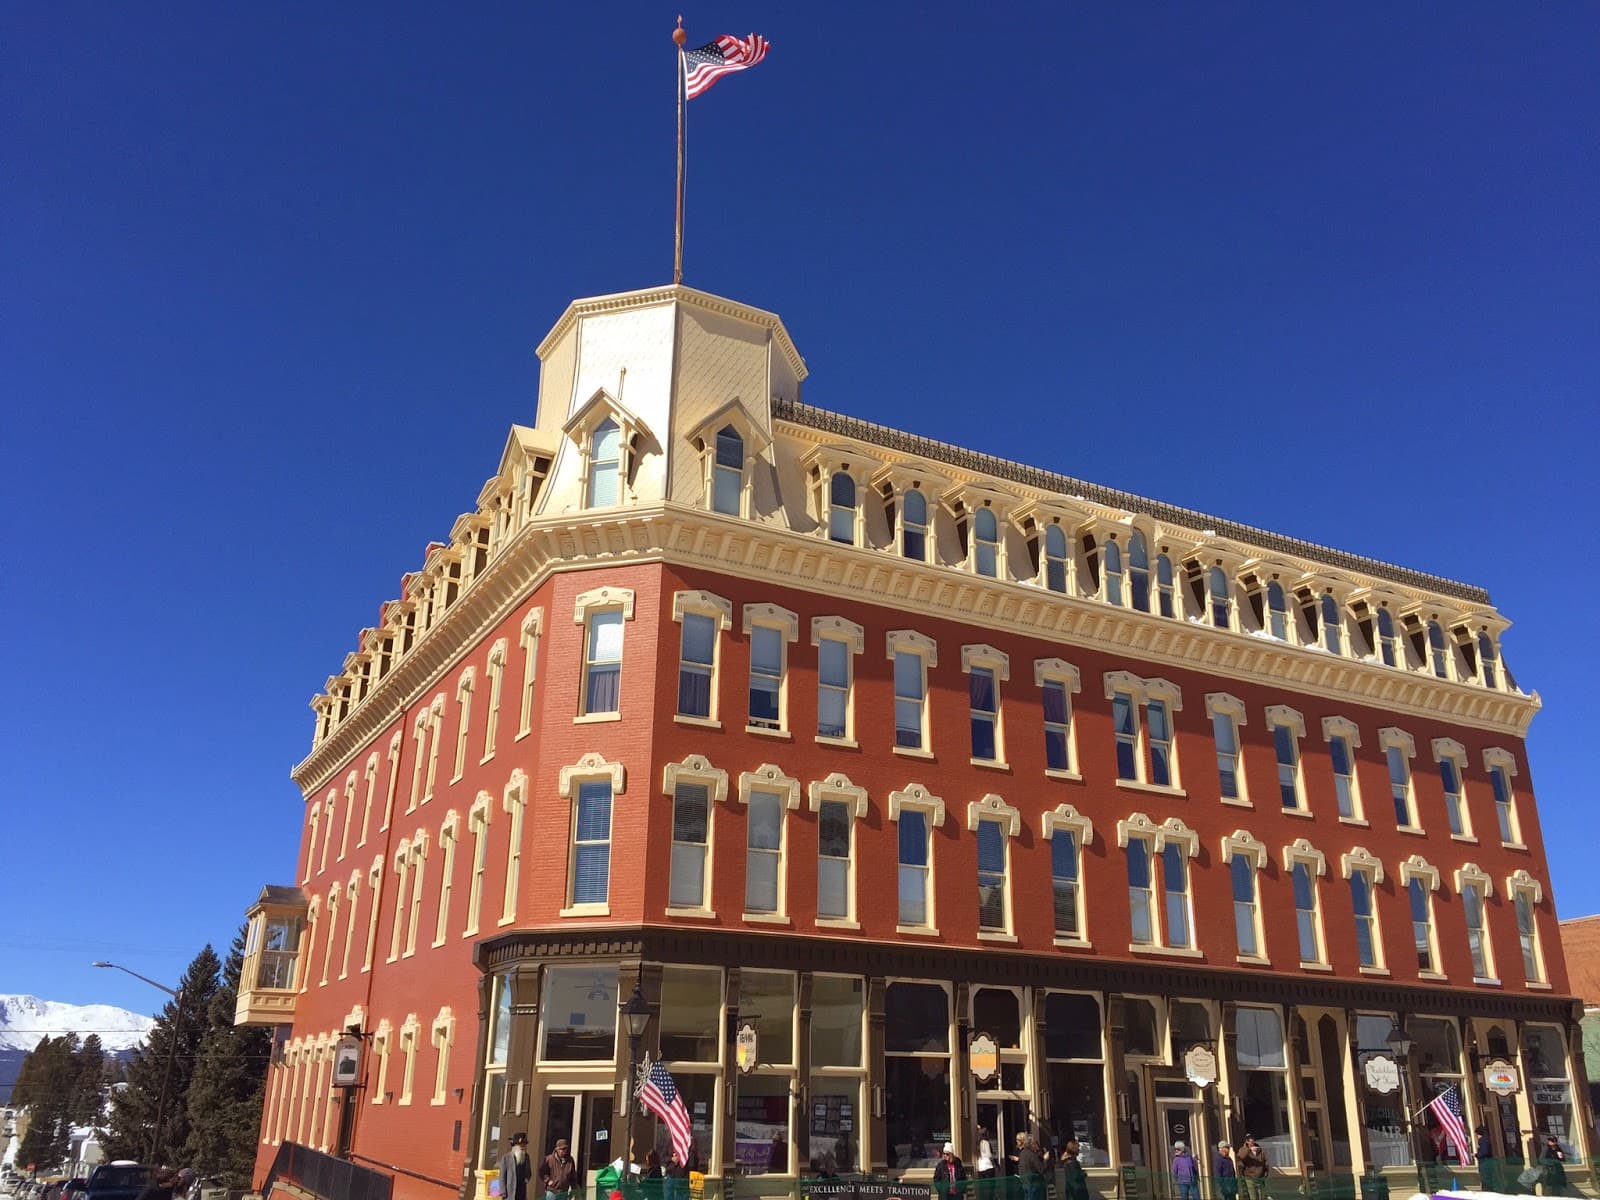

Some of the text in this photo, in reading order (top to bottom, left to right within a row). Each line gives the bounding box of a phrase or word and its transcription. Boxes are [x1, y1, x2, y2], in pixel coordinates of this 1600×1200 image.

[810, 1185, 930, 1196] EXCELLENCE MEETS TRADITION
